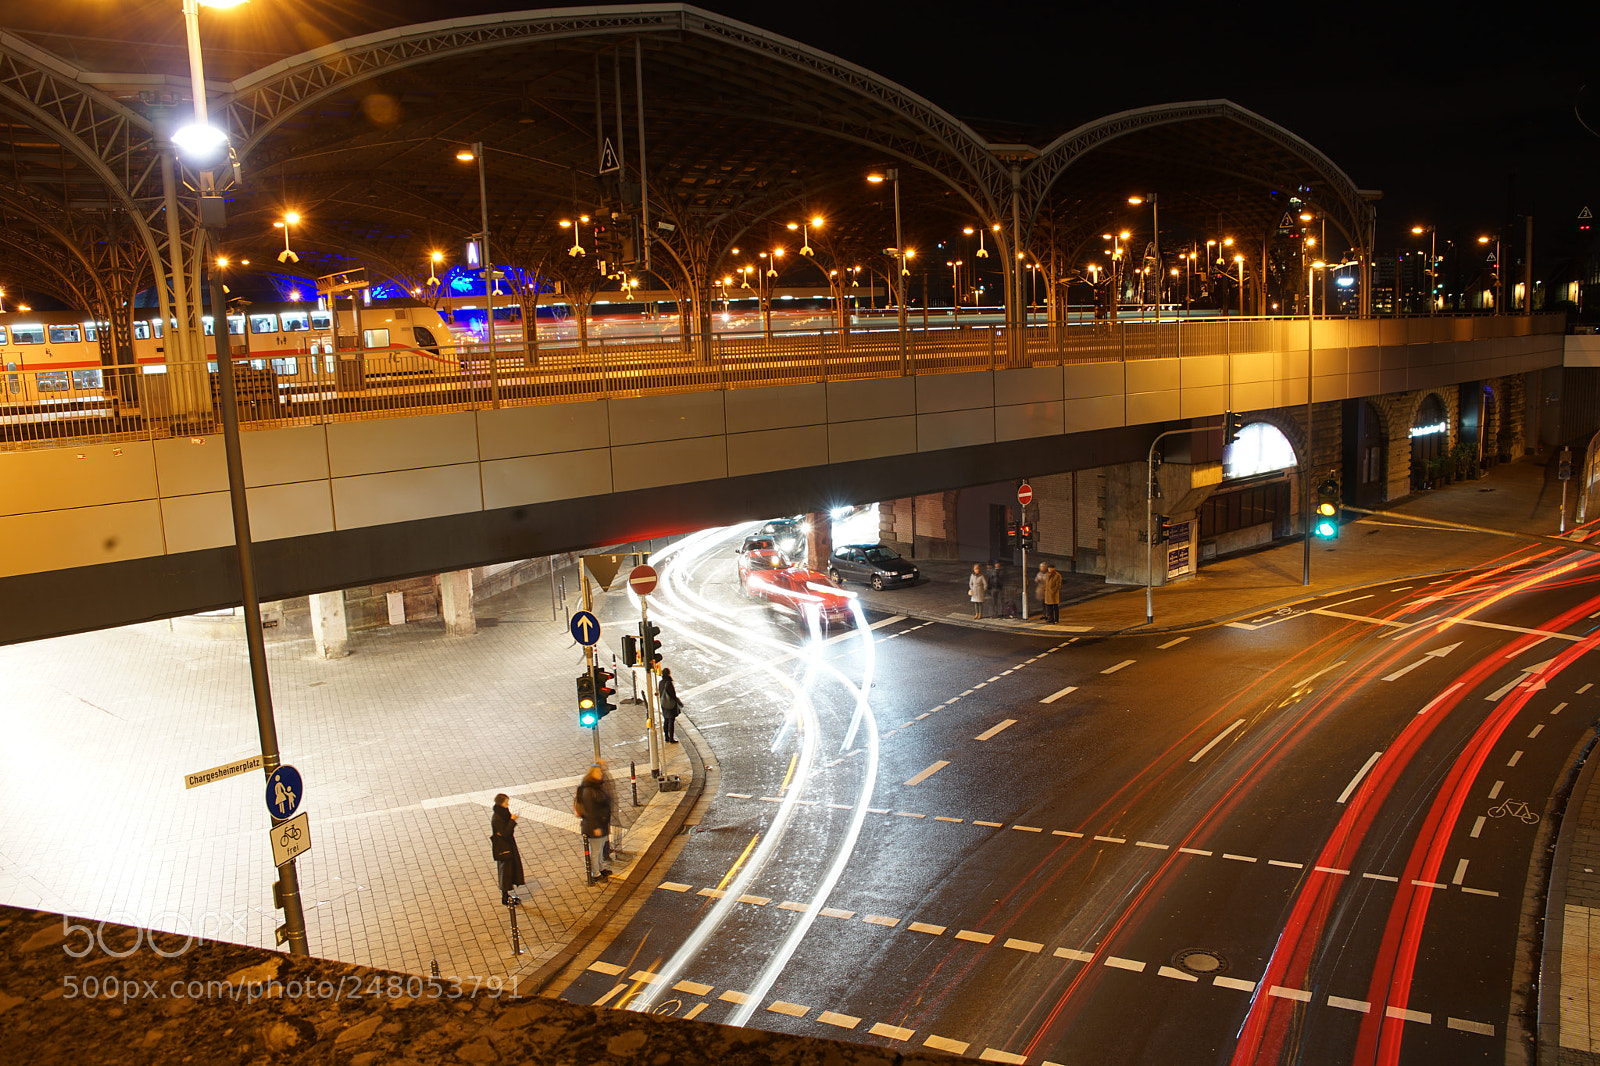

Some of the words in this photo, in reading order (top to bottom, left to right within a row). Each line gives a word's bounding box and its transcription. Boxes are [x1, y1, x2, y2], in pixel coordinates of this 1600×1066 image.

[606, 149, 612, 167] 3
[189, 759, 261, 786] Chargesheimerplatz
[286, 843, 300, 856] frei
